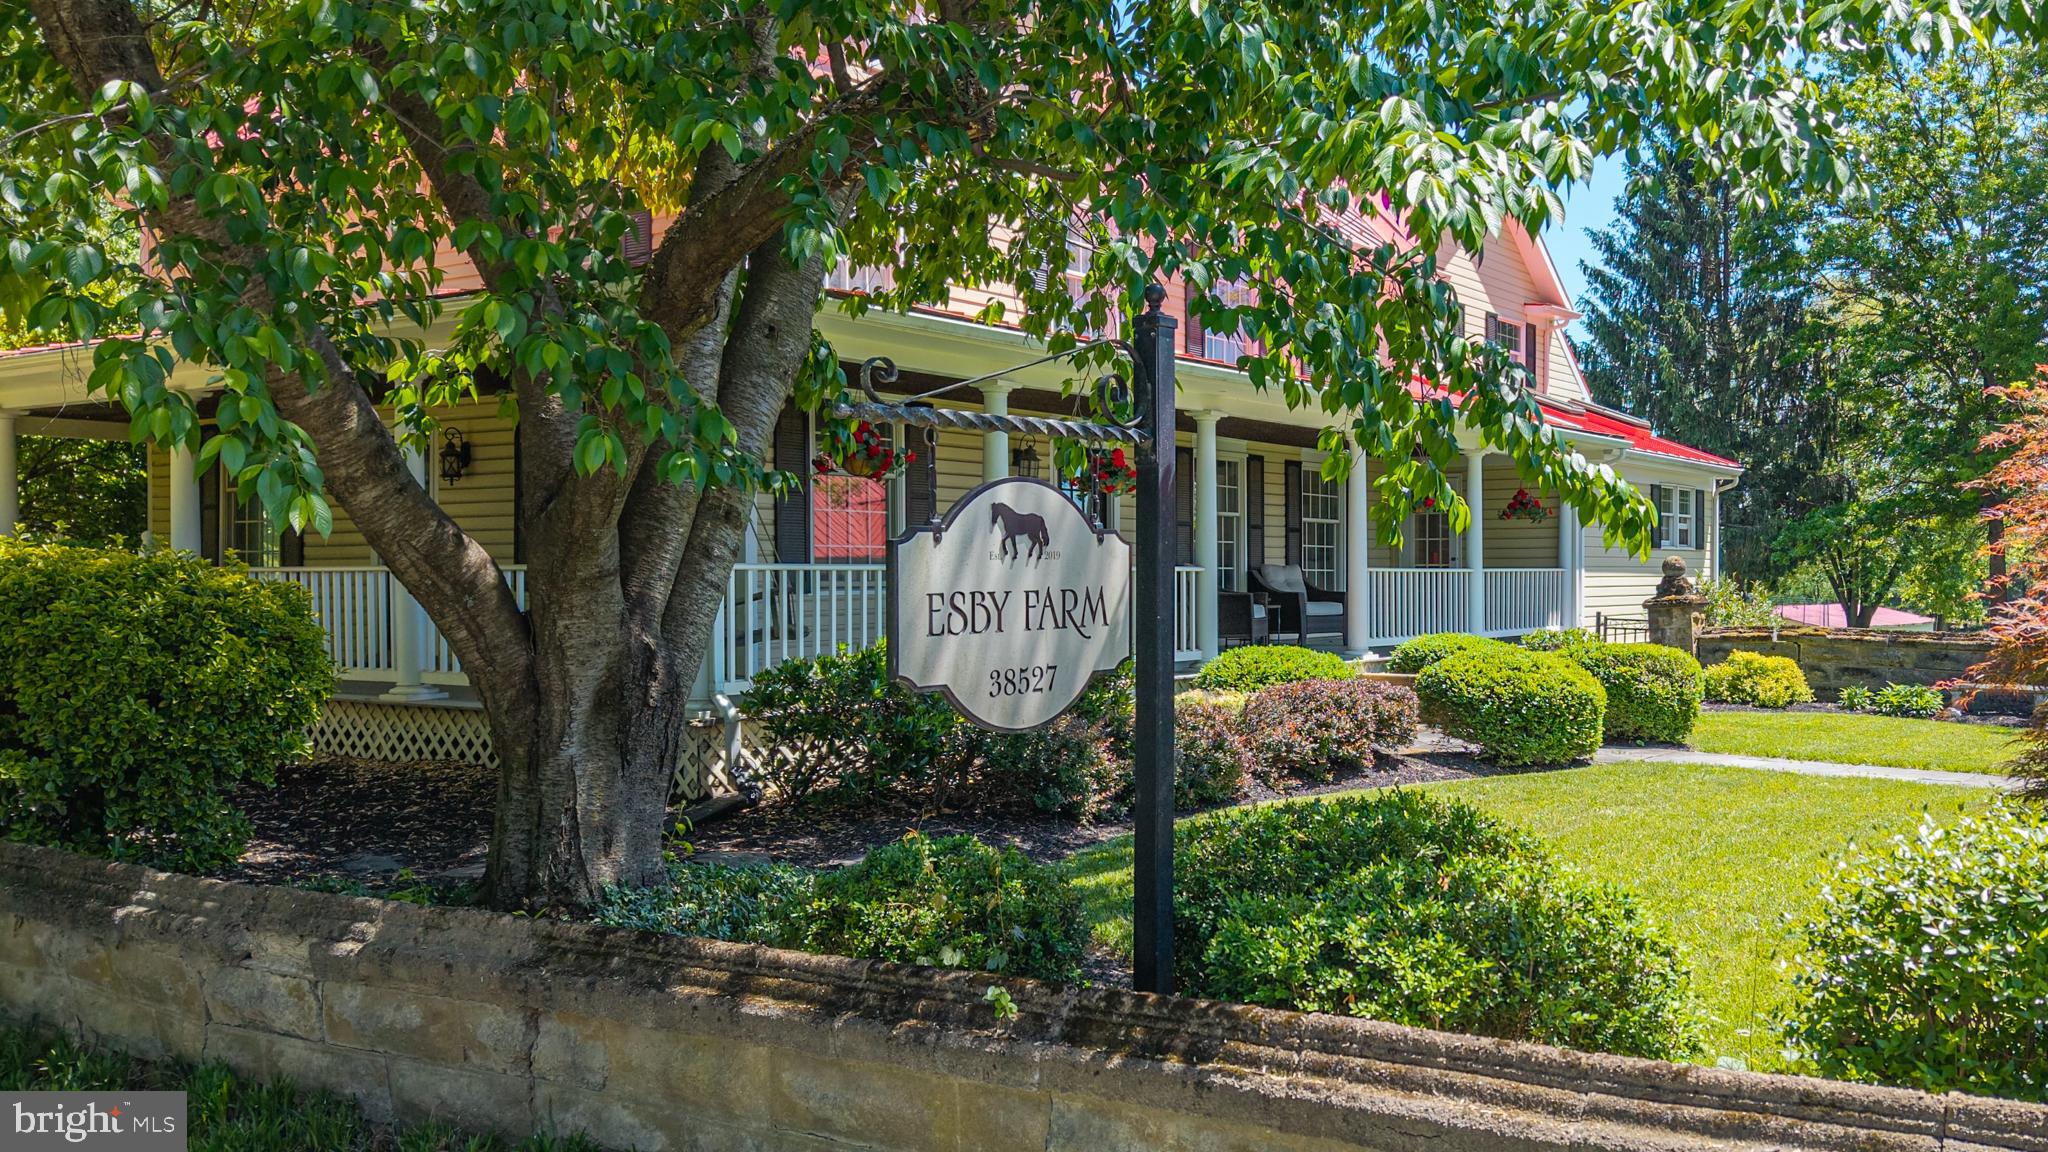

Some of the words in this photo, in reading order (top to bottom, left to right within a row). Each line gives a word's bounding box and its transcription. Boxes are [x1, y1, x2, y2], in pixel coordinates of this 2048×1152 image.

[1044, 551, 1061, 561] 2019
[926, 590, 1012, 638] ESBY
[1023, 585, 1110, 640] FARM
[988, 664, 1058, 698] 38527
